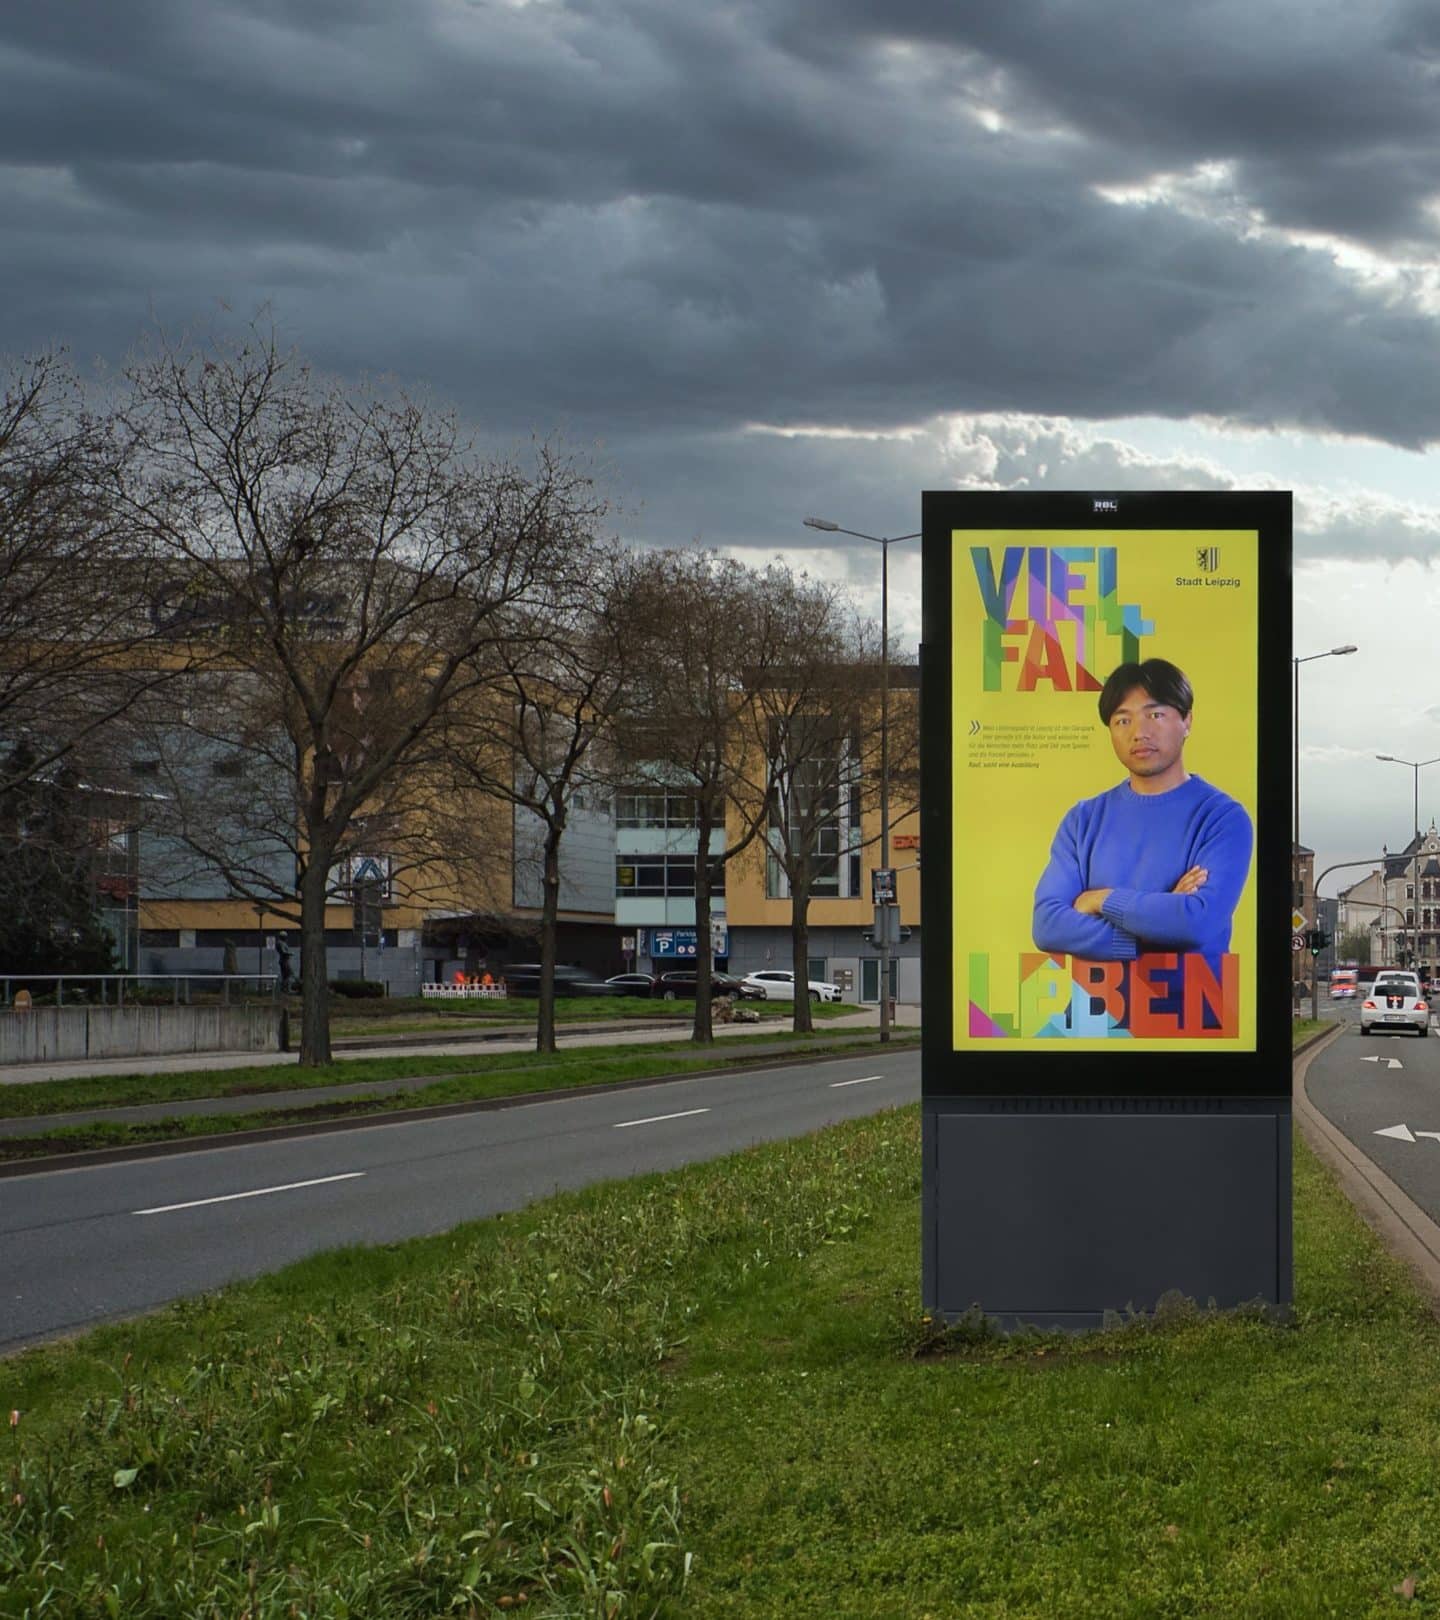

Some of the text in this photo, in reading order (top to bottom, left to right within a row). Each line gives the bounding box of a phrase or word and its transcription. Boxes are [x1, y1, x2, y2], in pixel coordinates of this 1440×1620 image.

[970, 546, 1140, 622] VIEL
[1175, 577, 1241, 588] Stadt Leipzig
[983, 618, 1156, 692] FALT
[969, 953, 1240, 1038] LEBEN
